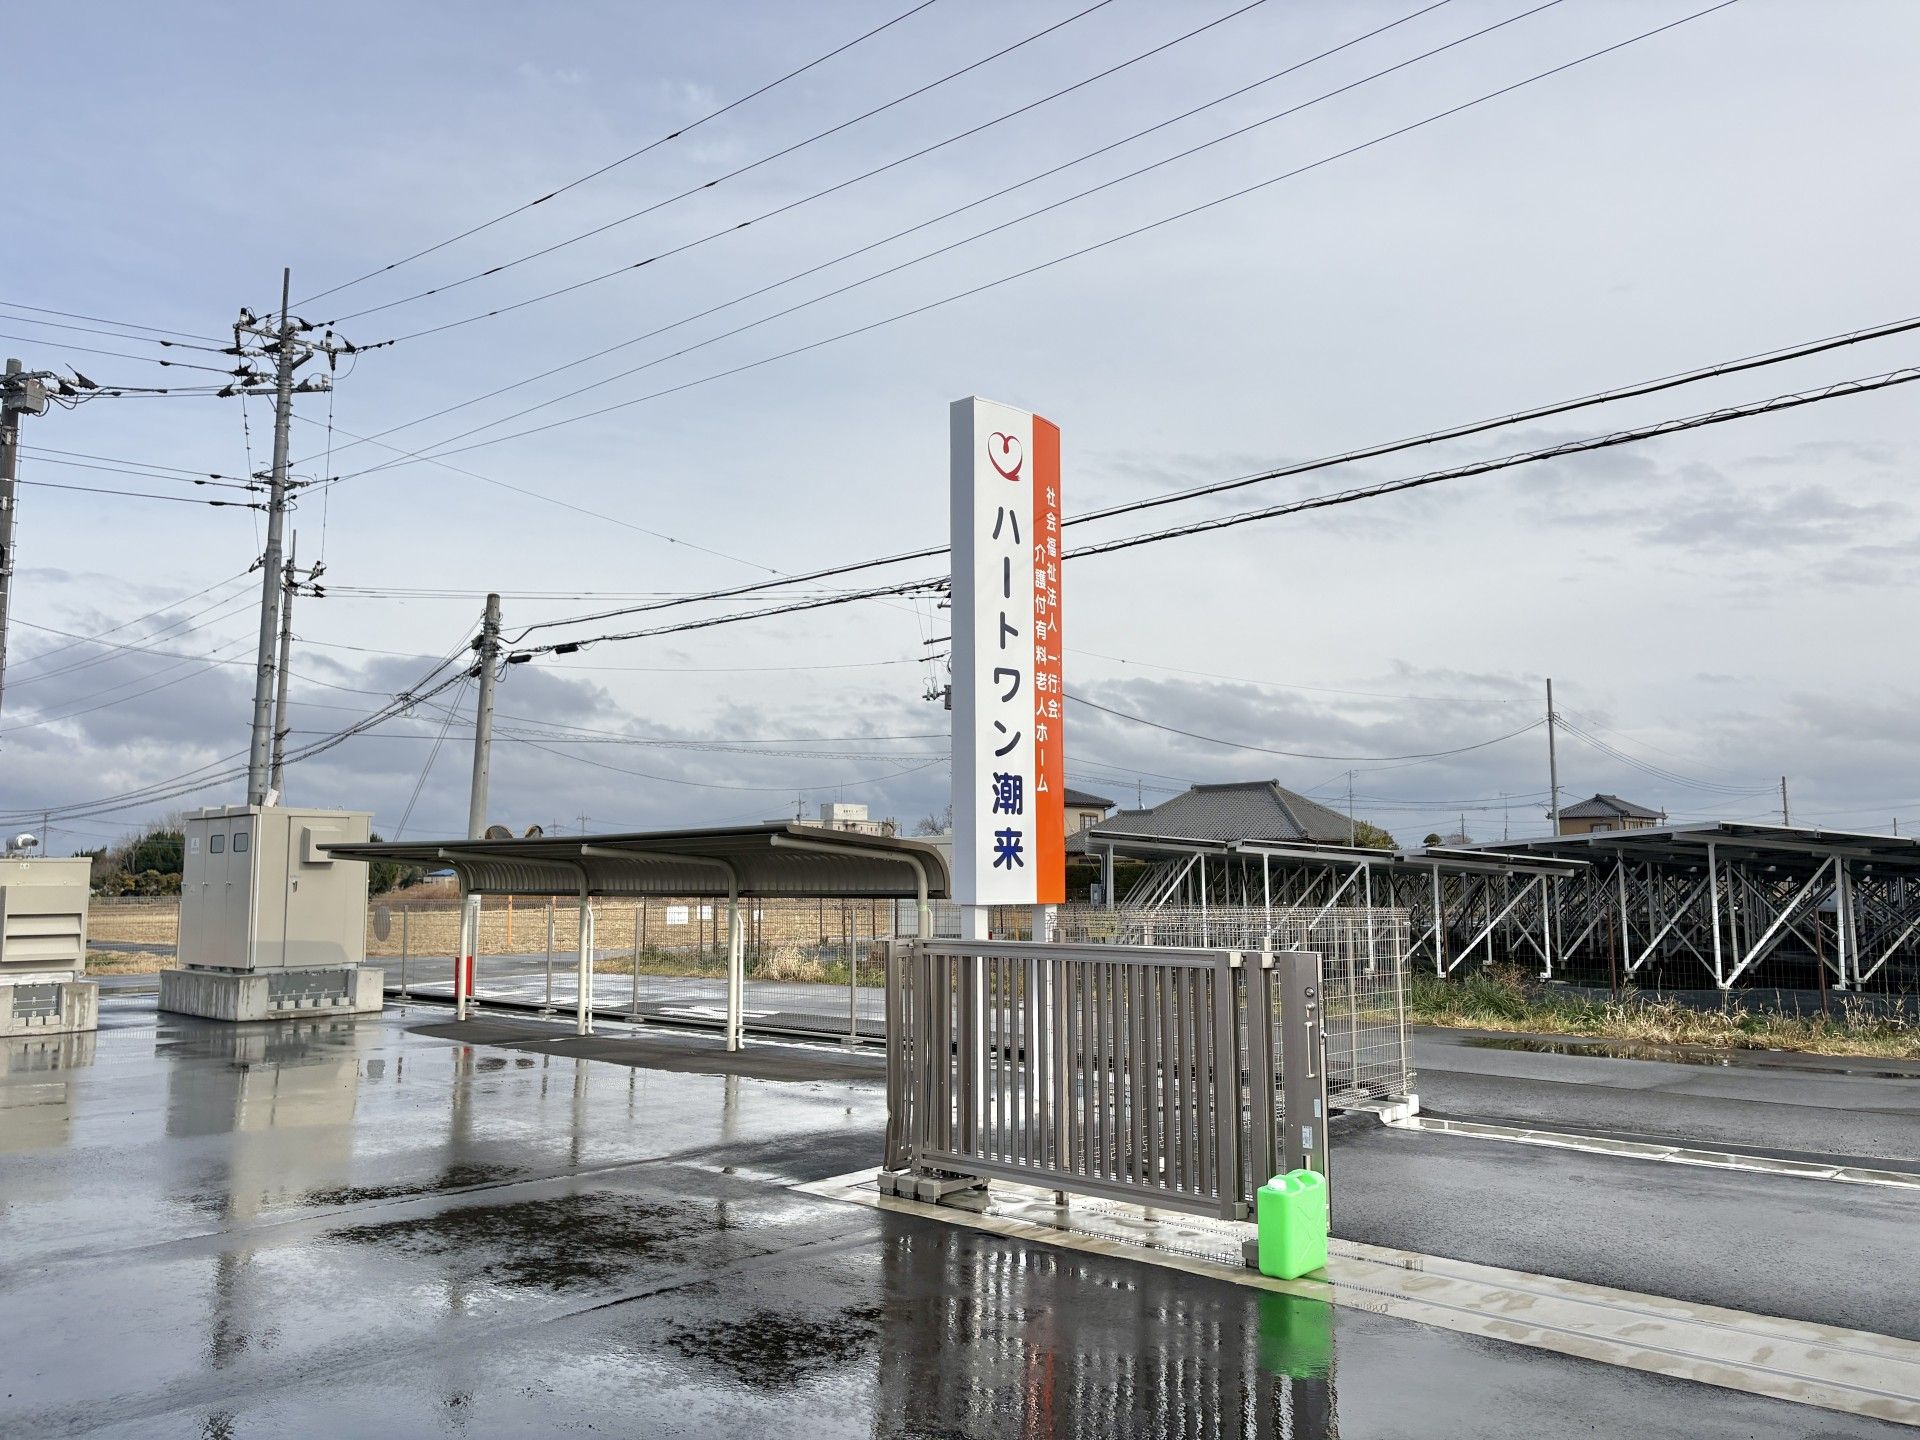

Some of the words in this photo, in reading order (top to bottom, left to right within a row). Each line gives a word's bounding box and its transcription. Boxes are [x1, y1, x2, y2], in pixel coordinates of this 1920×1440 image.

[992, 506, 1025, 870] ハートワン潮来
[1034, 543, 1049, 793] 介護付有料老人ホーム
